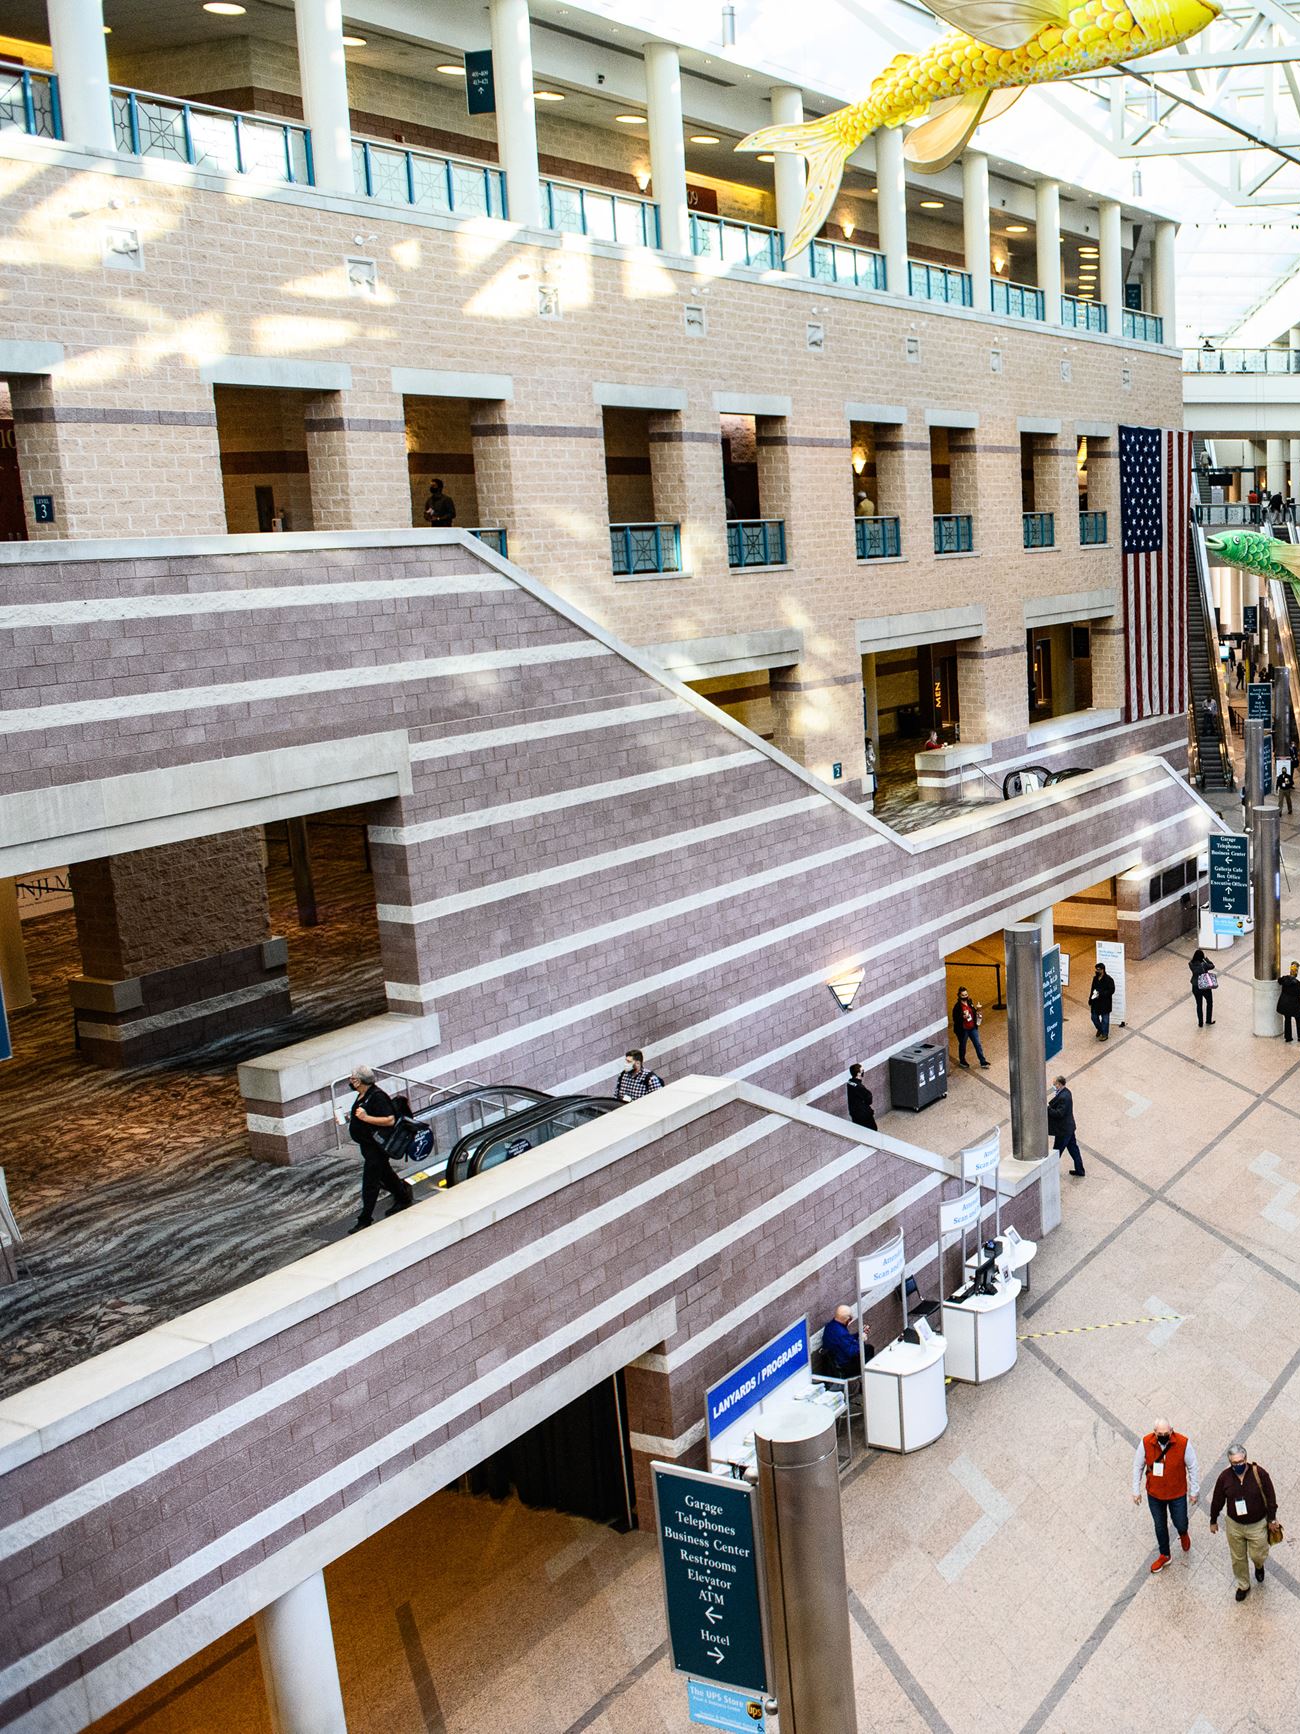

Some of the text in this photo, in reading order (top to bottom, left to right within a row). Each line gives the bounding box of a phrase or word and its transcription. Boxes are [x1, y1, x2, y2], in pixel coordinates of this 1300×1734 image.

[41, 504, 48, 519] 3
[934, 681, 942, 708] MEN
[975, 1159, 989, 1171] Scan
[953, 1212, 968, 1225] Scan
[873, 1268, 889, 1281] Scan
[712, 1376, 757, 1420] LANYARDS
[761, 1339, 804, 1381] PROGRAMS
[684, 1494, 724, 1516] Garage
[675, 1510, 736, 1536] Telephones
[664, 1526, 750, 1558] Business Center
[680, 1548, 737, 1573] Restrooms
[687, 1568, 732, 1590] Elevator
[698, 1589, 725, 1606] ATM
[700, 1629, 730, 1647] Hotel
[690, 1686, 705, 1697] The
[706, 1690, 722, 1701] UPS
[723, 1695, 744, 1708] Store
[747, 1706, 762, 1718] ups
